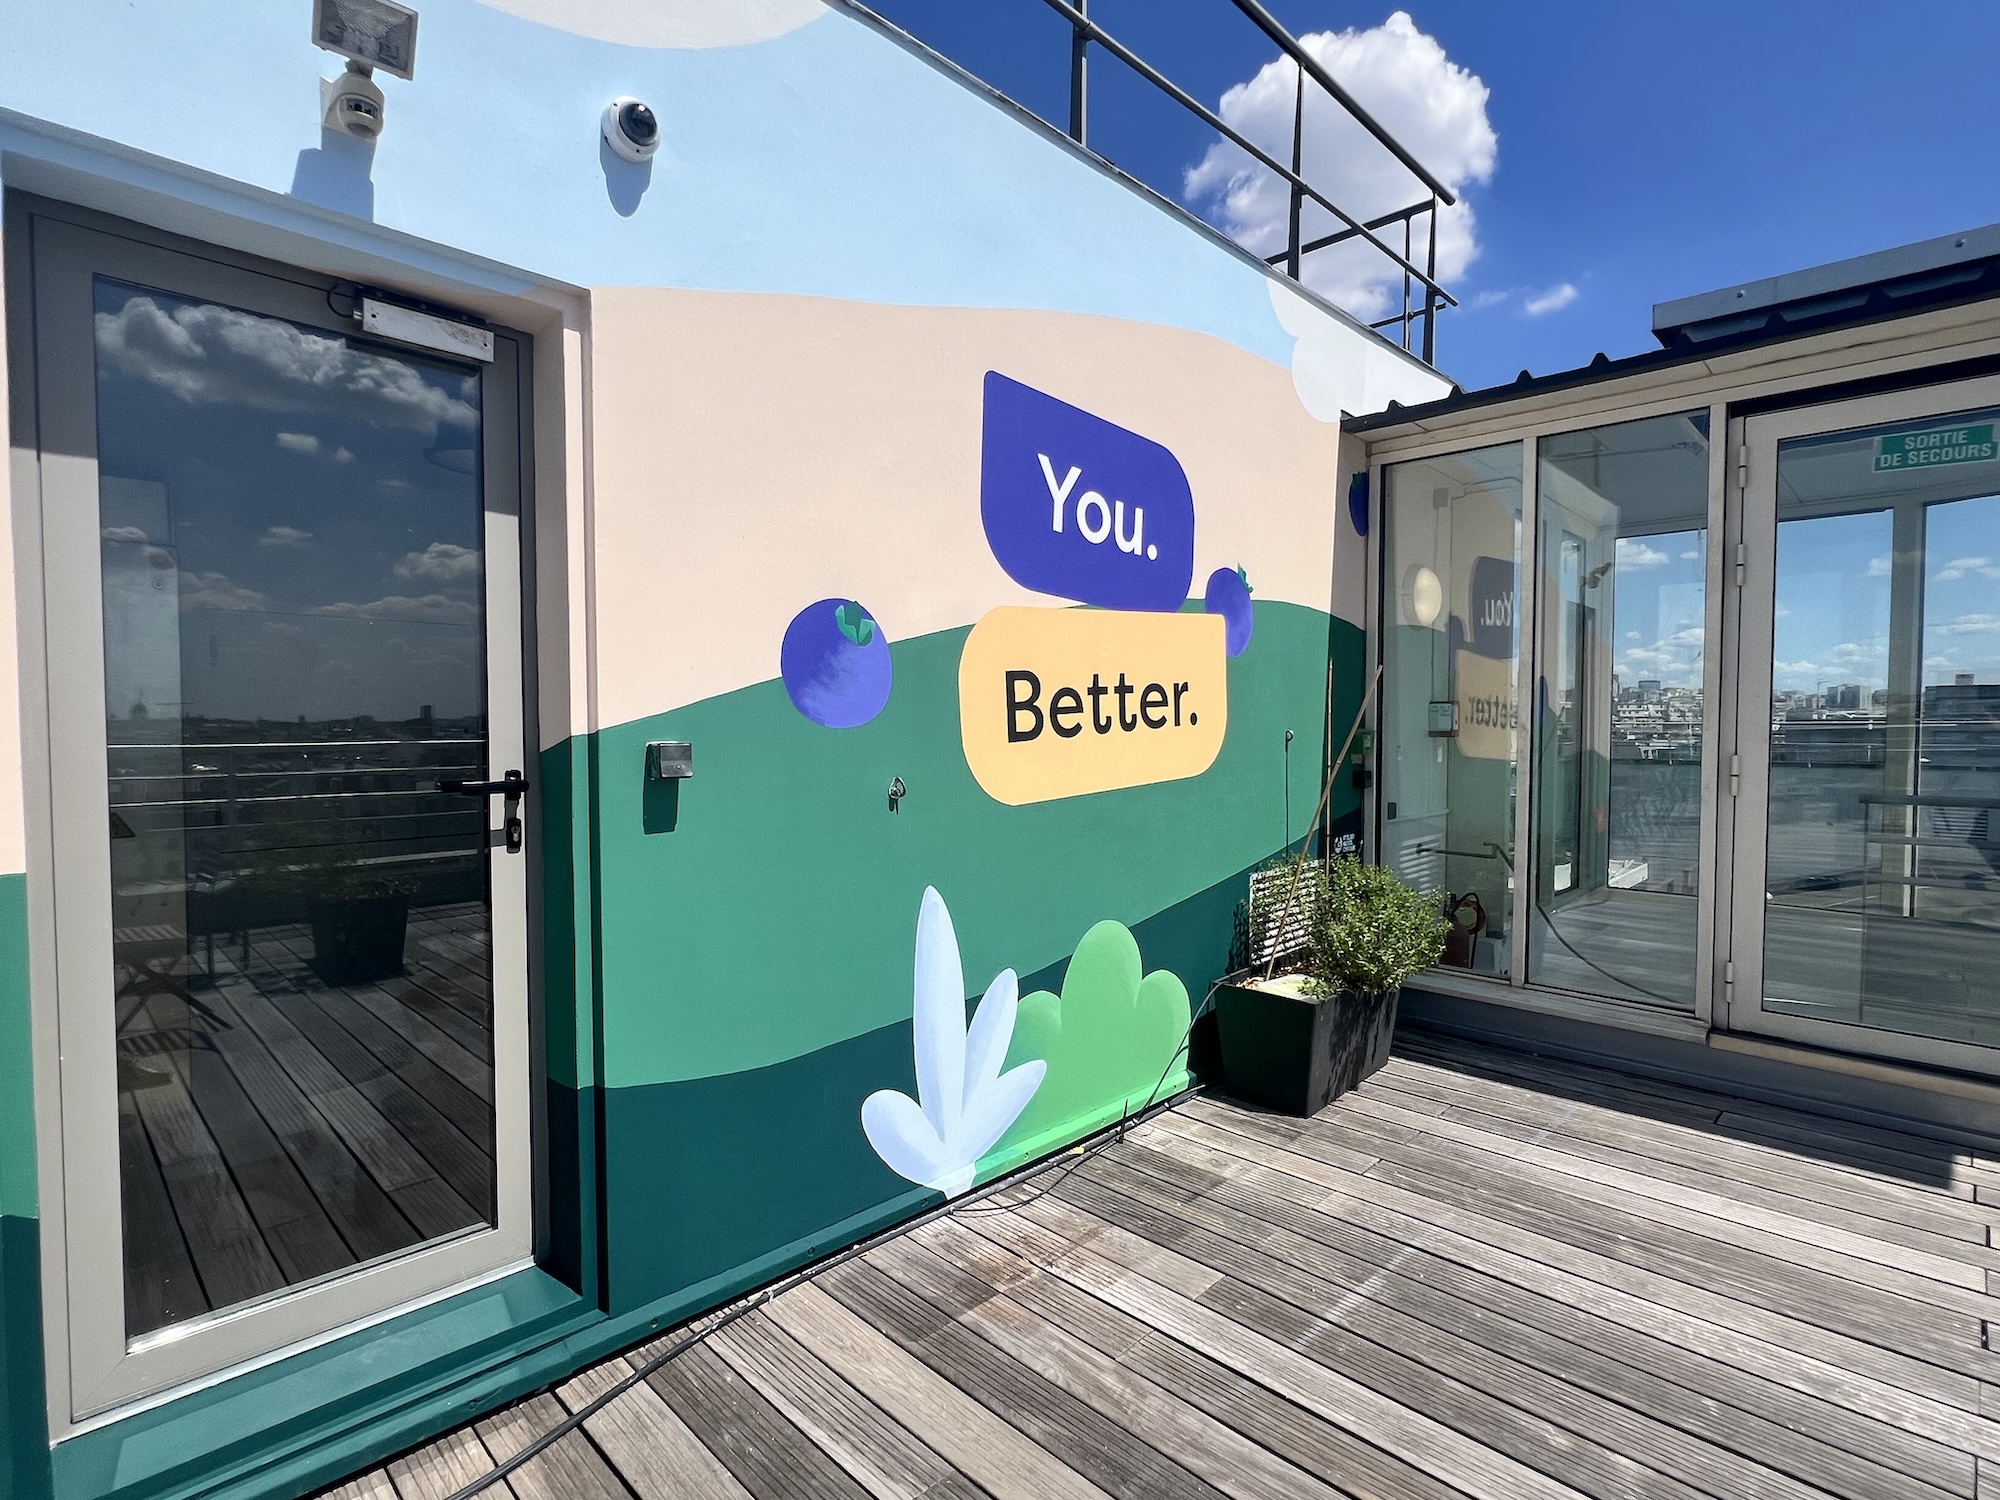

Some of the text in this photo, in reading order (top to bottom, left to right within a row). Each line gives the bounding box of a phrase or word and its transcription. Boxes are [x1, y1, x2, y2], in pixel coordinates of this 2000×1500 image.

[1880, 442, 1992, 467] DE SECOURS
[1905, 430, 1969, 450] SORTIE
[1037, 453, 1159, 561] You.
[1005, 669, 1198, 743] Better.
